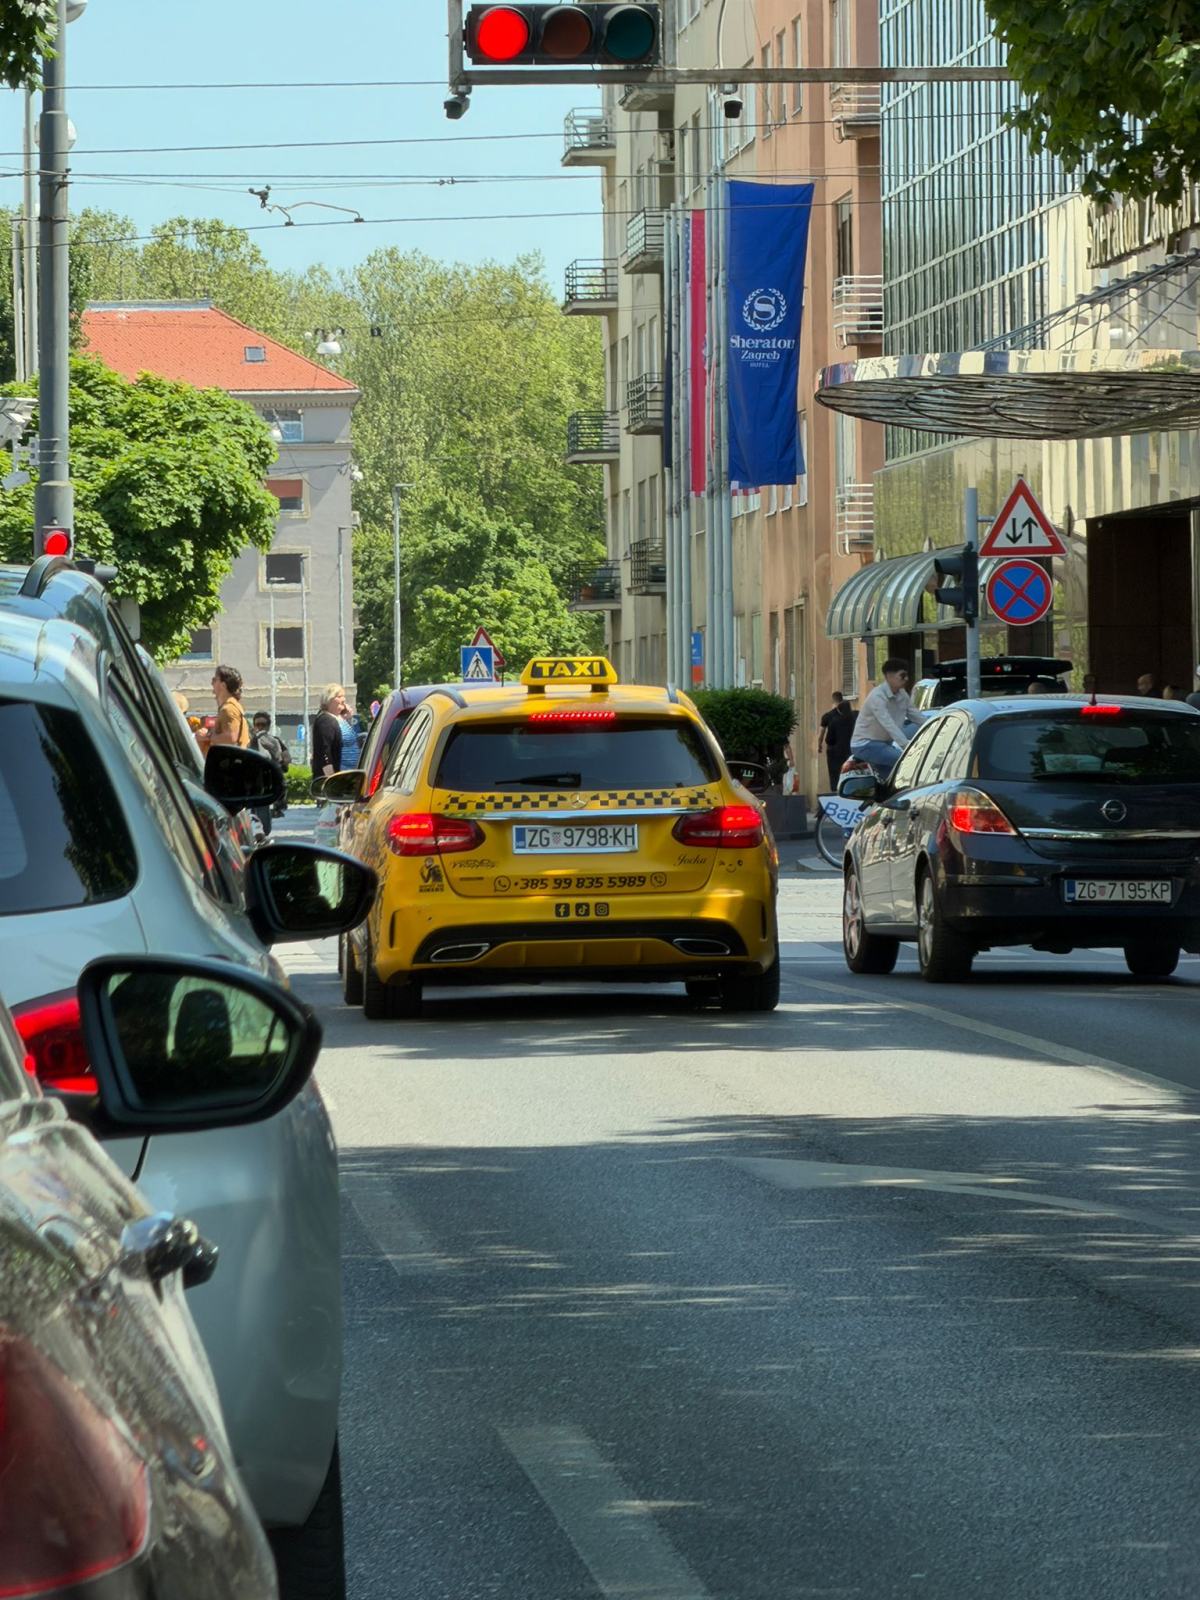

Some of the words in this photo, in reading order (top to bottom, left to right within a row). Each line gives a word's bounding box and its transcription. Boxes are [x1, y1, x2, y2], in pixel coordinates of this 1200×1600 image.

[753, 295, 776, 321] S
[730, 335, 796, 349] Sheraton
[740, 350, 780, 362] Zagreb
[535, 661, 600, 677] TAXI
[824, 801, 865, 825] Bajs
[527, 828, 551, 848] ZG
[551, 876, 574, 890] 99
[575, 875, 604, 889] 835
[607, 874, 647, 888] 5989
[1077, 882, 1097, 899] ZG
